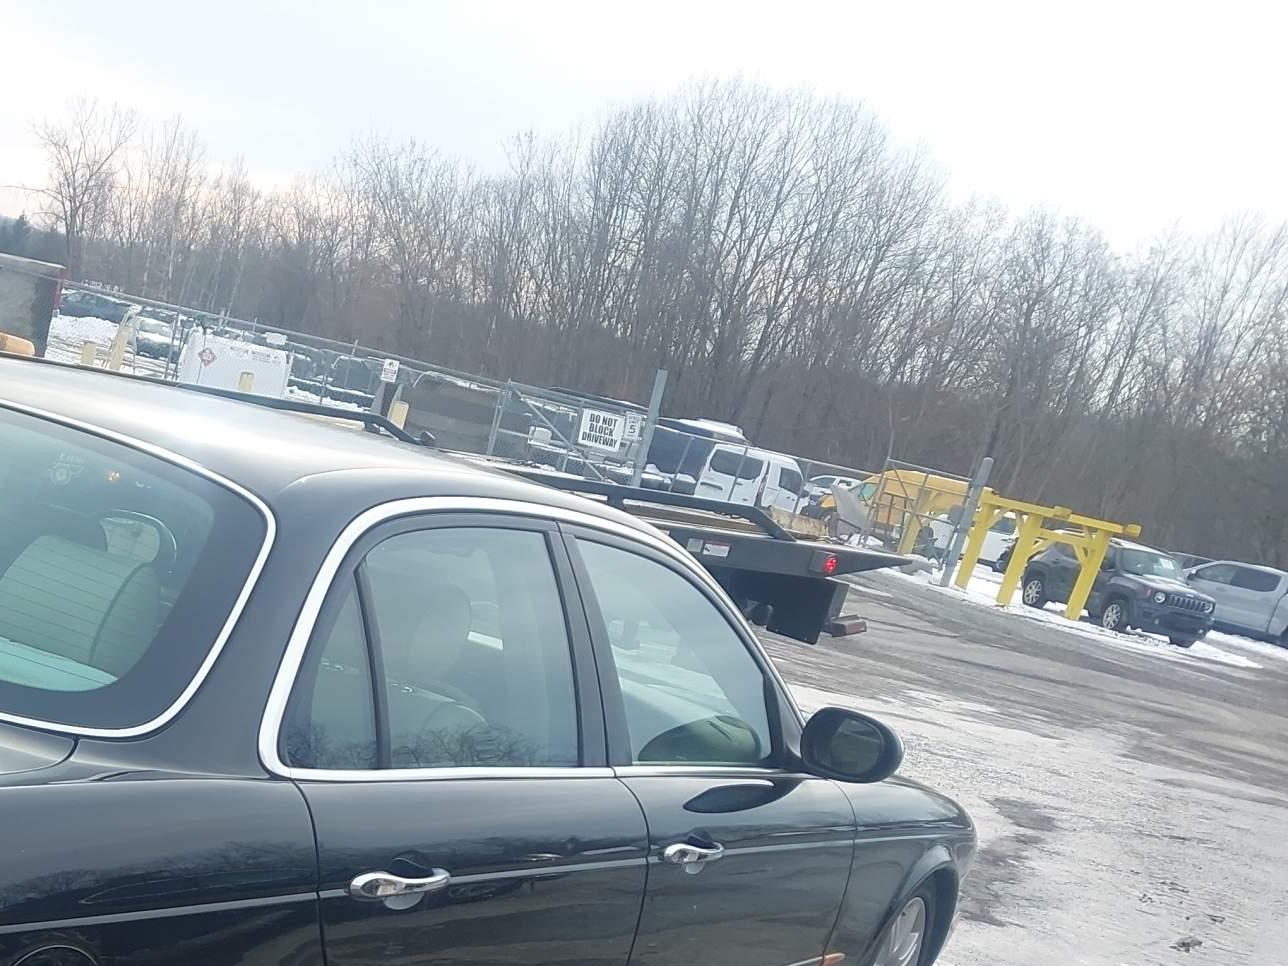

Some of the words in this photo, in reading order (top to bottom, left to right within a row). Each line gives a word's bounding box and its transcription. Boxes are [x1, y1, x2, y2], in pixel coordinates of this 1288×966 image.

[590, 413, 601, 423] DO
[602, 415, 618, 428] NOT
[589, 422, 614, 437] BLOCK
[582, 431, 618, 448] DRIVEWAY
